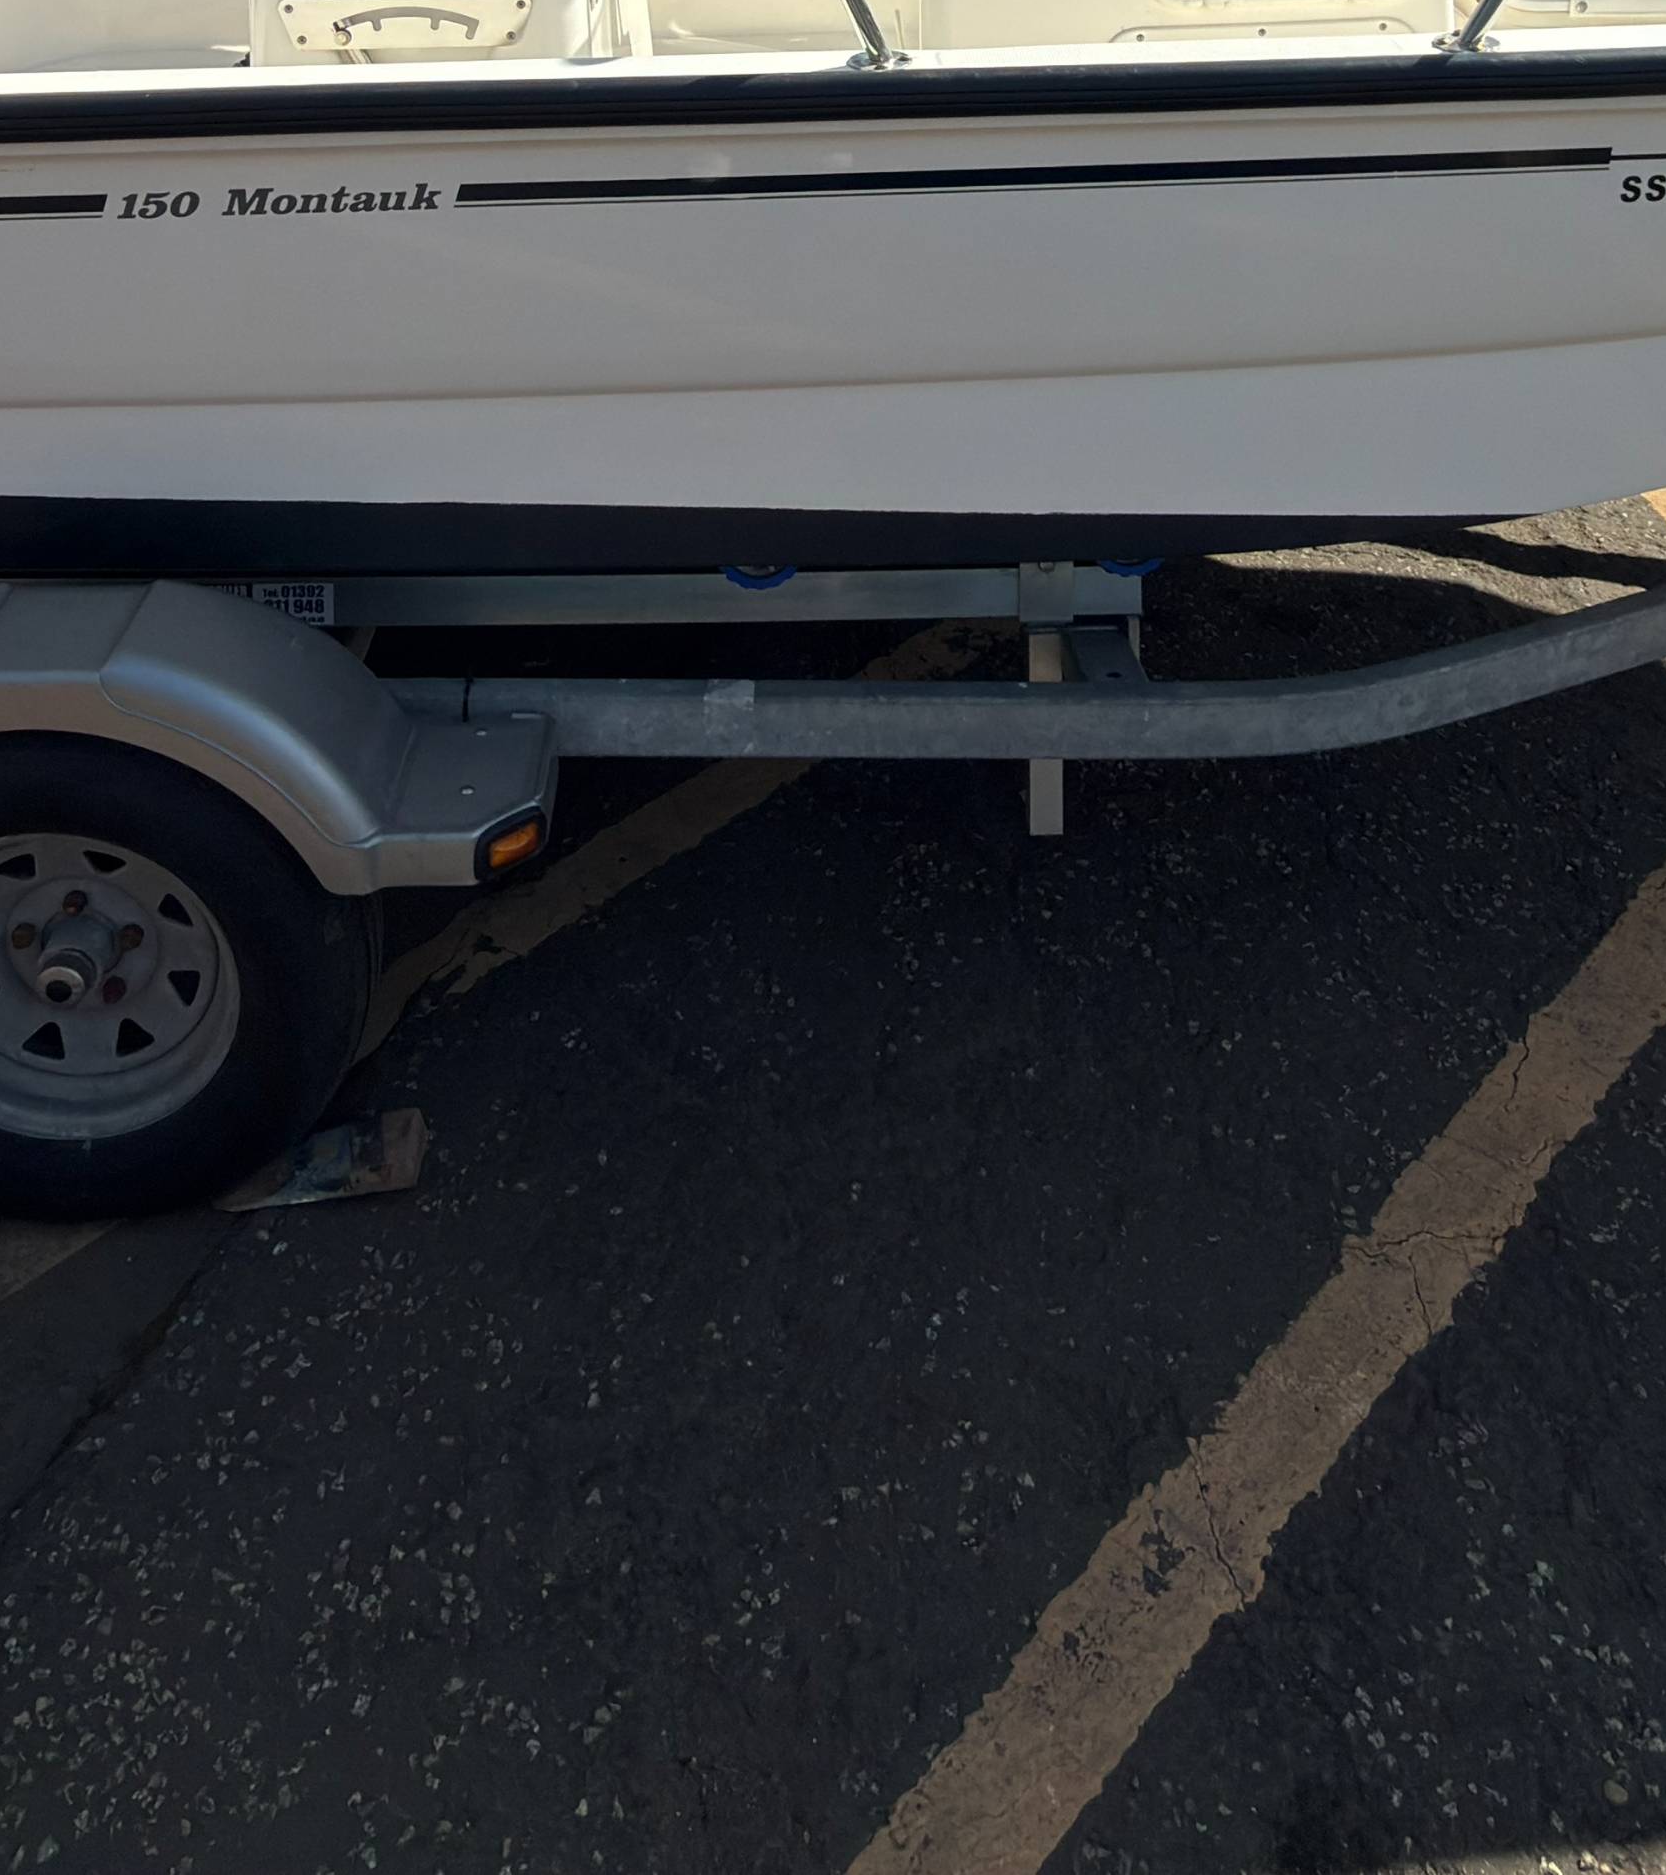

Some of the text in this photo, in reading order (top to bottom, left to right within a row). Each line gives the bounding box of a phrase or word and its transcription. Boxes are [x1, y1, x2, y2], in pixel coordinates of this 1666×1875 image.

[117, 183, 442, 220] 150 Montauk
[293, 599, 325, 614] 948
